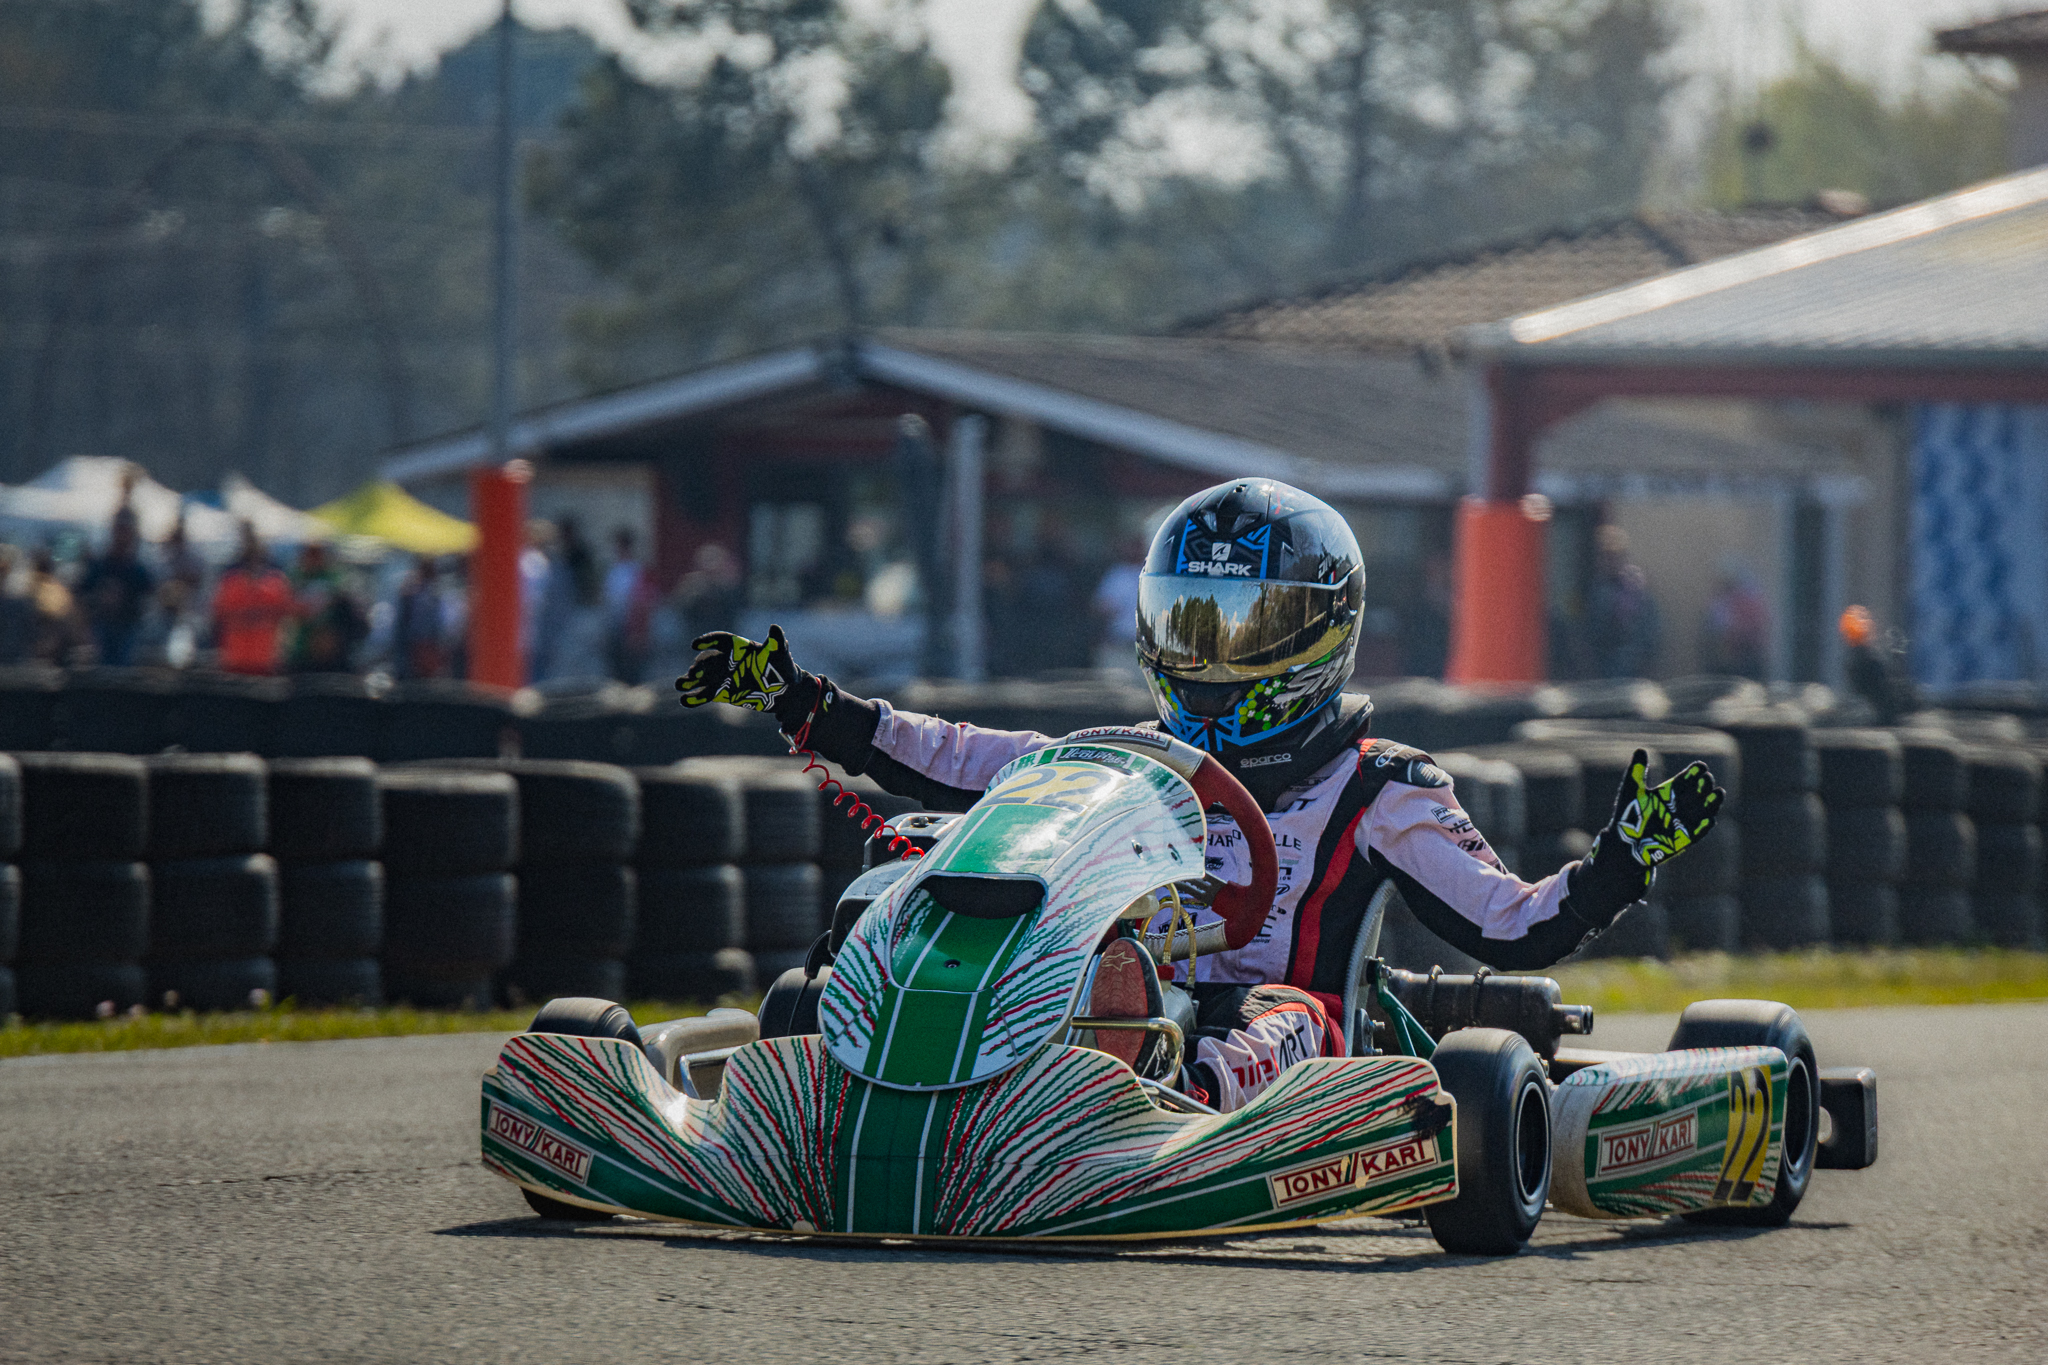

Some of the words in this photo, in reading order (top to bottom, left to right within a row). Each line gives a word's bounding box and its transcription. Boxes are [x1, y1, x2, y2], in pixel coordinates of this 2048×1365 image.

[1188, 560, 1252, 577] SHARK
[1240, 752, 1292, 768] sparco
[980, 767, 1113, 815] 22
[493, 1106, 536, 1146] TONY
[541, 1131, 589, 1173] KART
[1604, 1127, 1651, 1165] TONY
[1658, 1112, 1696, 1154] KART
[1712, 1066, 1770, 1201] 22
[1273, 1158, 1343, 1197] TONY
[1360, 1137, 1426, 1176] KART
